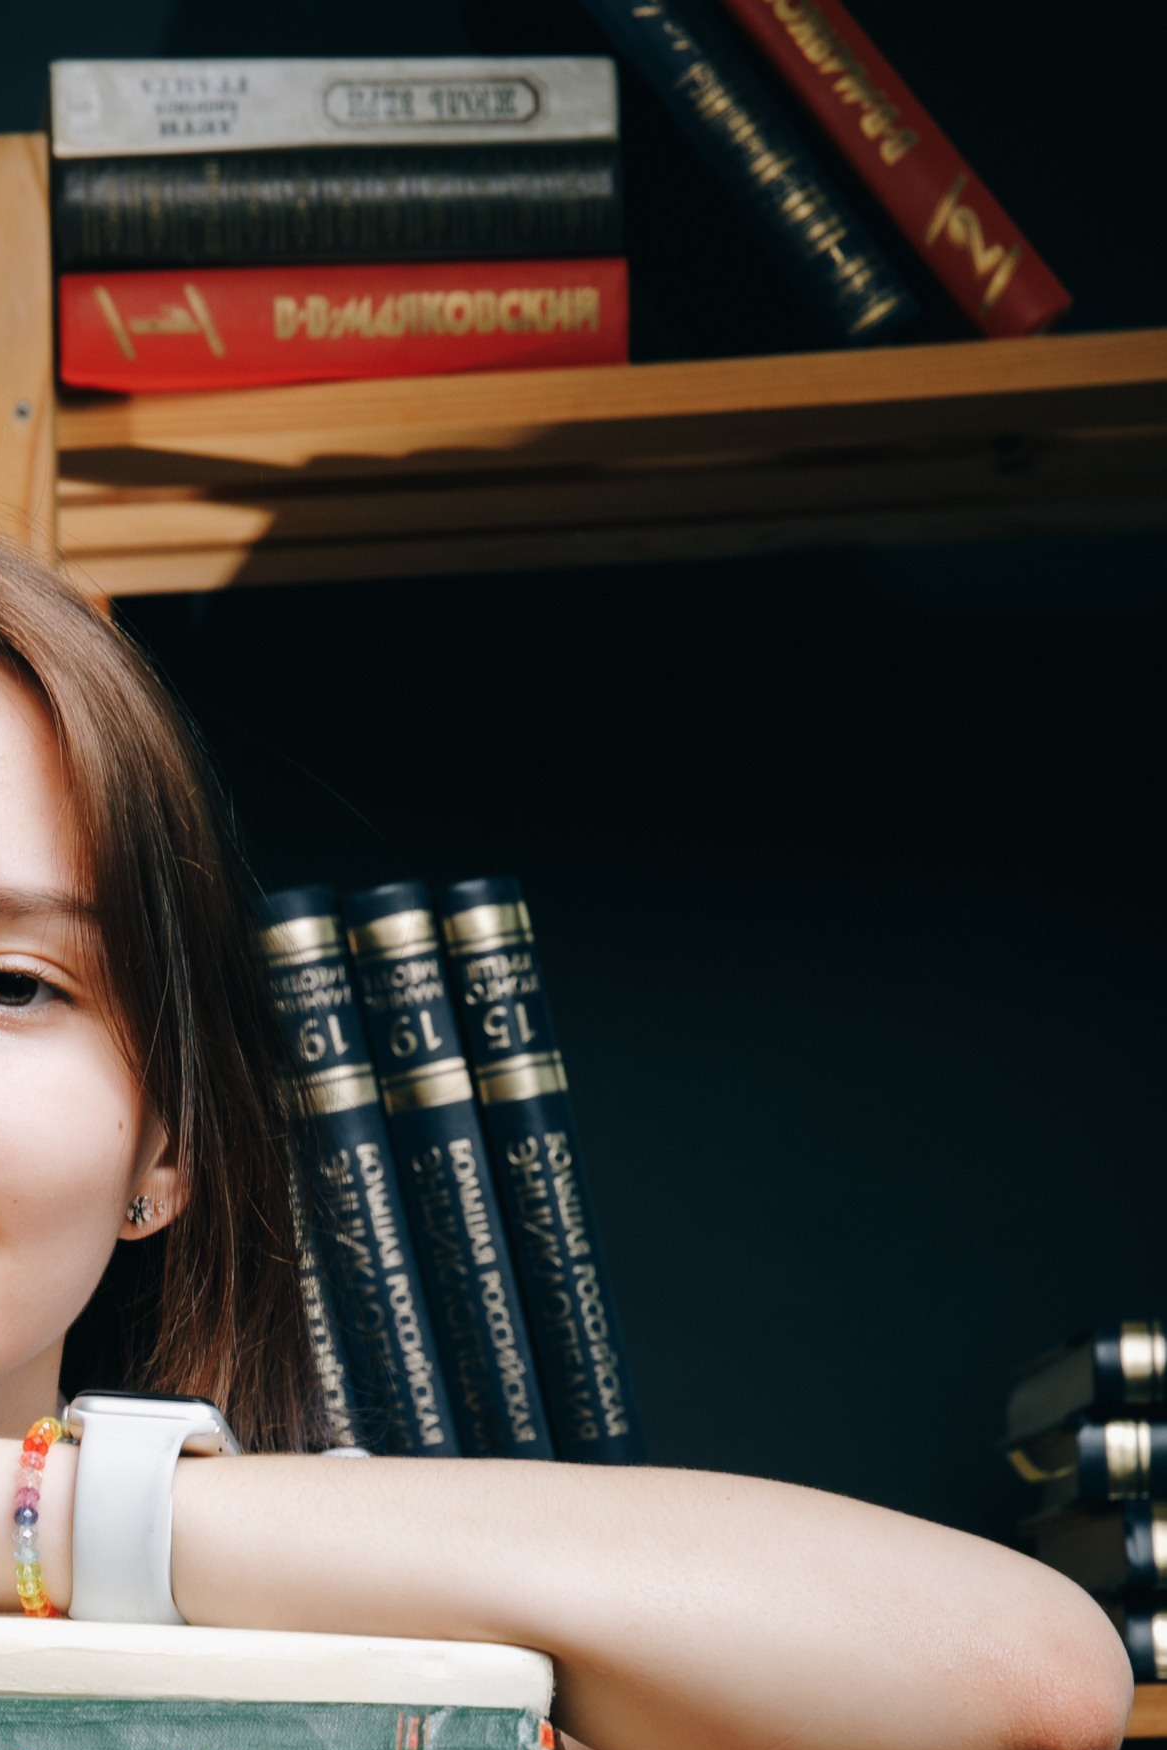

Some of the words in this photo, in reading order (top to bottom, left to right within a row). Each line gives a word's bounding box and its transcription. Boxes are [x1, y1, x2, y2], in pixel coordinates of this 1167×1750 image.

[297, 1012, 350, 1062] 19
[391, 1009, 443, 1058] 19
[482, 1002, 537, 1050] 15
[356, 1143, 403, 1269] БОЛЬШАЯ
[386, 1272, 444, 1446] РОССИЙСКАЯ
[448, 1137, 496, 1267] БОЛЬШАЯ
[477, 1270, 536, 1443] РОССИЙСКАЯ
[543, 1131, 591, 1259] БОЛЬШАЯ
[573, 1265, 630, 1438] РОССИЙСКАЯ
